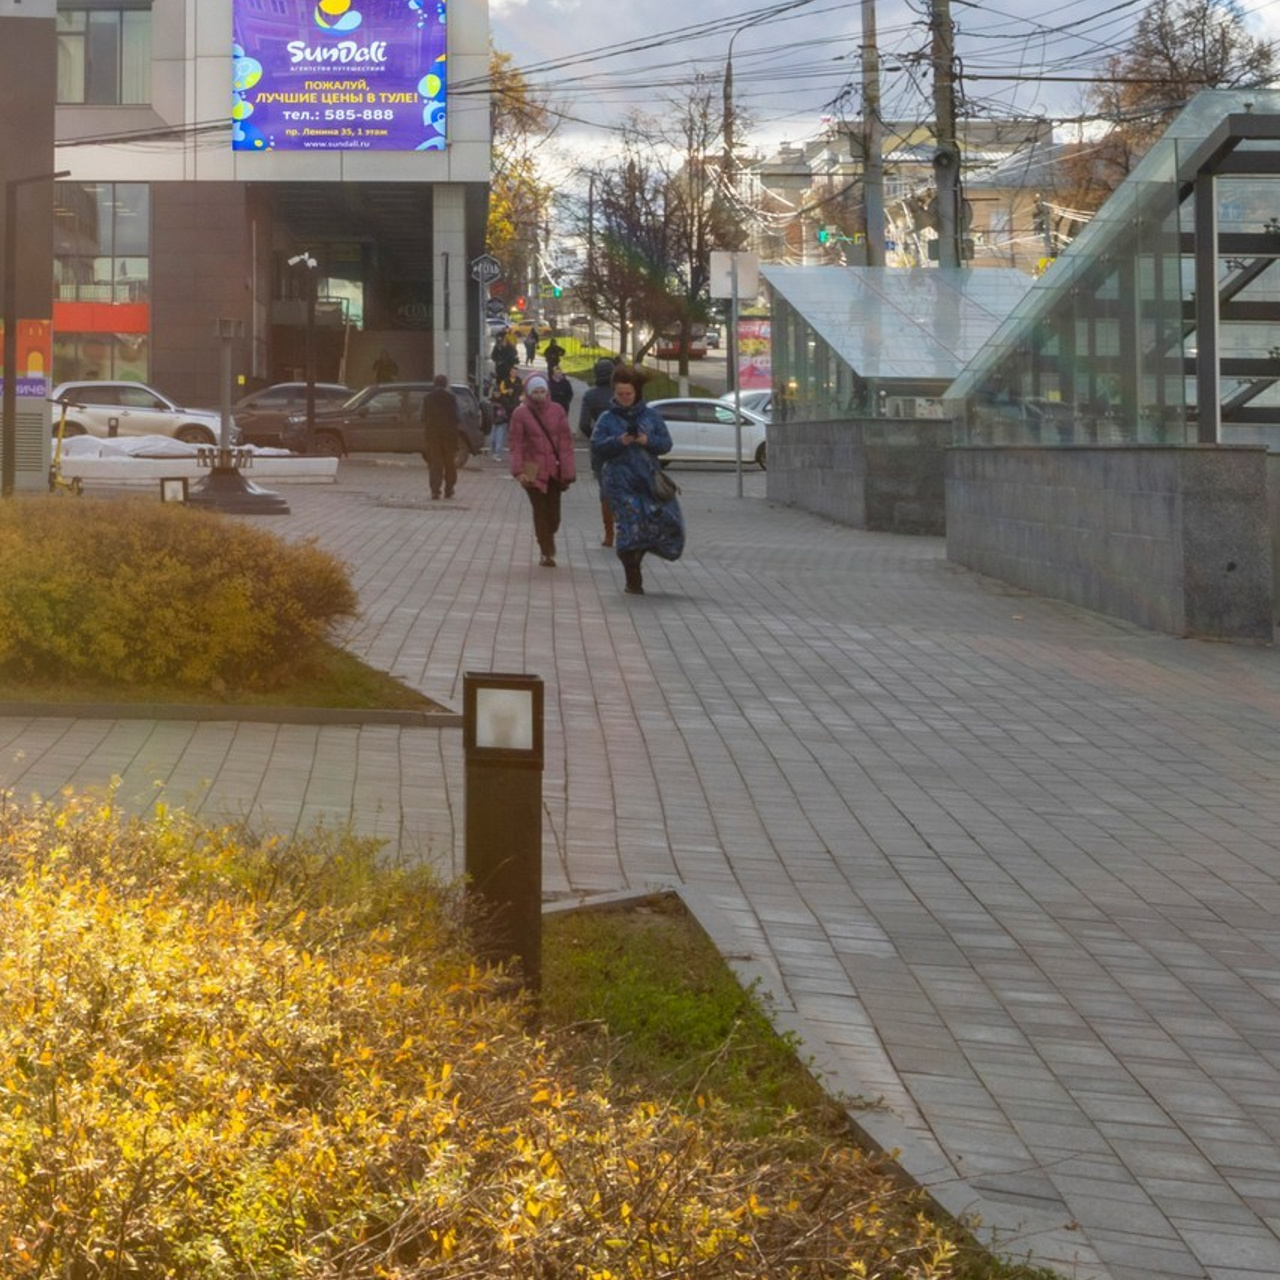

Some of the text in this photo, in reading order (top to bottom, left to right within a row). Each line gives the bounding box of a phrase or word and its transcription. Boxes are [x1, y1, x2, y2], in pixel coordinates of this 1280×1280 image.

[287, 41, 387, 63] SunDali
[305, 79, 370, 91] ПОЖАЛУЙ,
[256, 93, 418, 104] ЛУЧШИЕ ЦЕНЫ В ТУЛЕ!
[325, 110, 393, 120] 585-888
[286, 129, 300, 137] пр.
[341, 128, 354, 137] 35,
